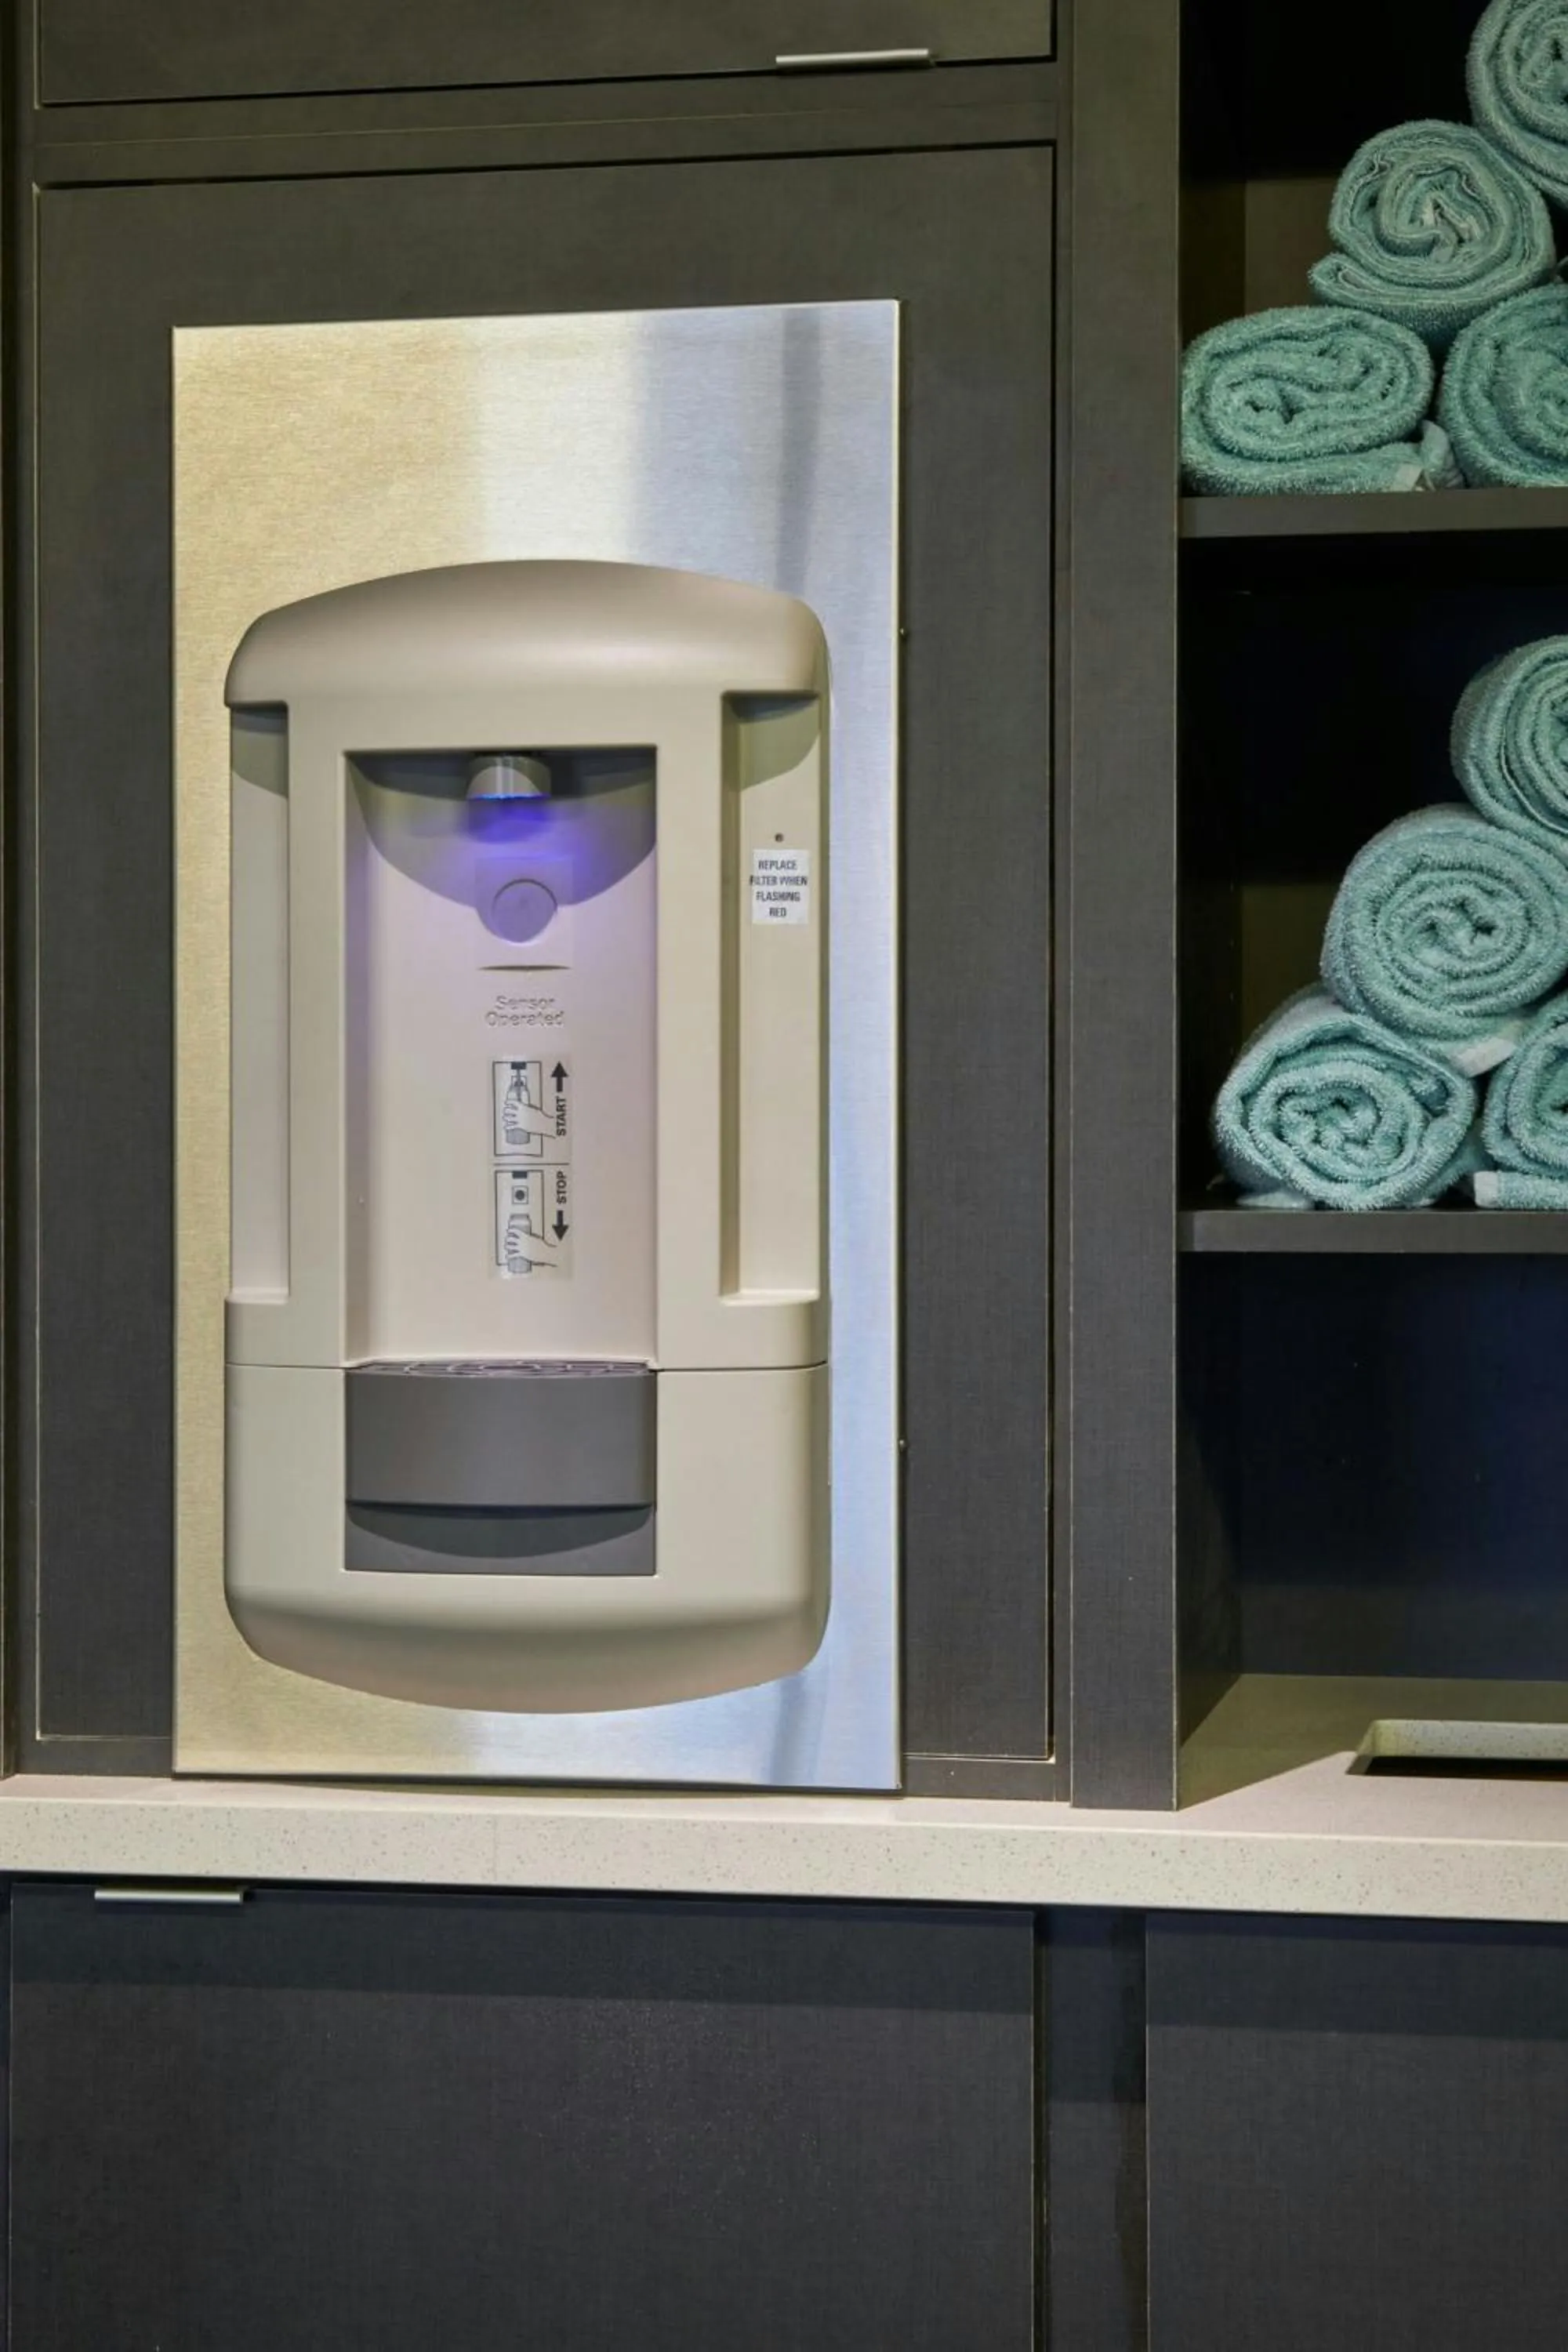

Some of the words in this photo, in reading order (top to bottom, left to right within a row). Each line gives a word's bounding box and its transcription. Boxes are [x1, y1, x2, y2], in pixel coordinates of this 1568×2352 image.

[758, 860, 797, 870] REPLACE
[750, 875, 778, 886] FILTER
[779, 876, 808, 886] WHEN
[756, 891, 800, 902] FLASHING
[769, 907, 786, 916] RED
[495, 995, 555, 1010] Sensor
[485, 1010, 565, 1026] Operated
[556, 1096, 566, 1136] START
[556, 1171, 567, 1204] STOP
